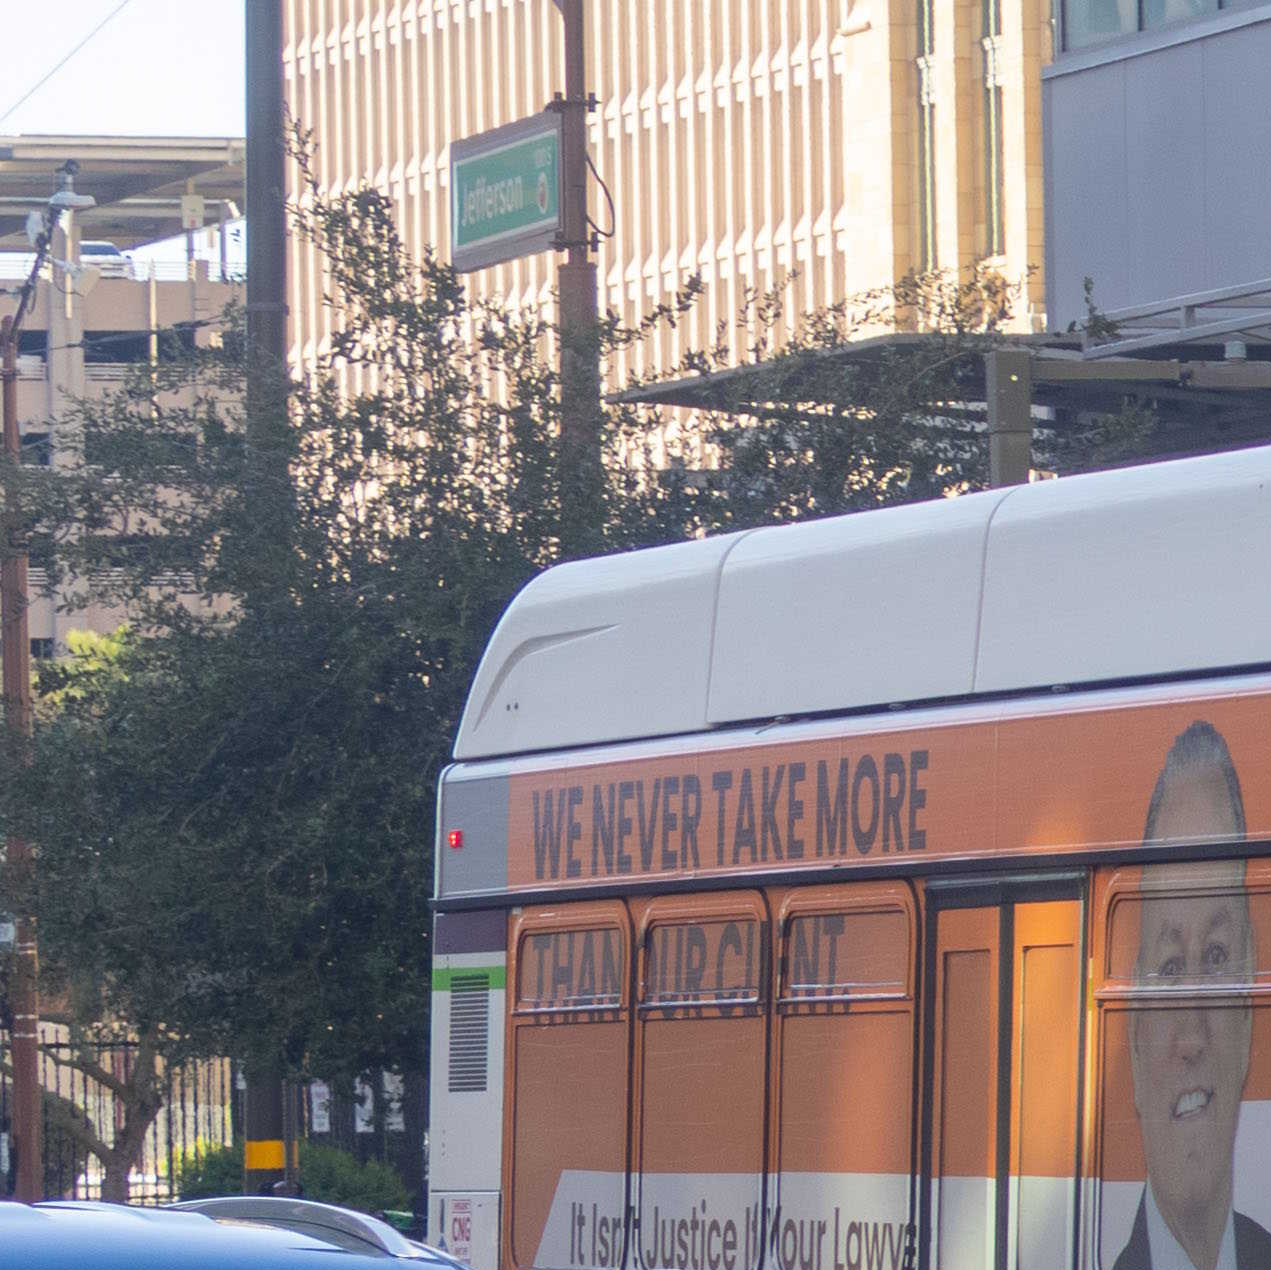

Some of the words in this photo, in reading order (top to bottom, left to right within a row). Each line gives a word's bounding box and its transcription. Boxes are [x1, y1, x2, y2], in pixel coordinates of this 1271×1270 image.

[532, 786, 584, 880] WE
[591, 774, 700, 876] NEVER
[712, 762, 806, 866] TAKE
[815, 750, 929, 858] MORE
[532, 927, 625, 1024] THAN
[570, 1201, 586, 1266] It
[591, 1203, 640, 1268] Isnt
